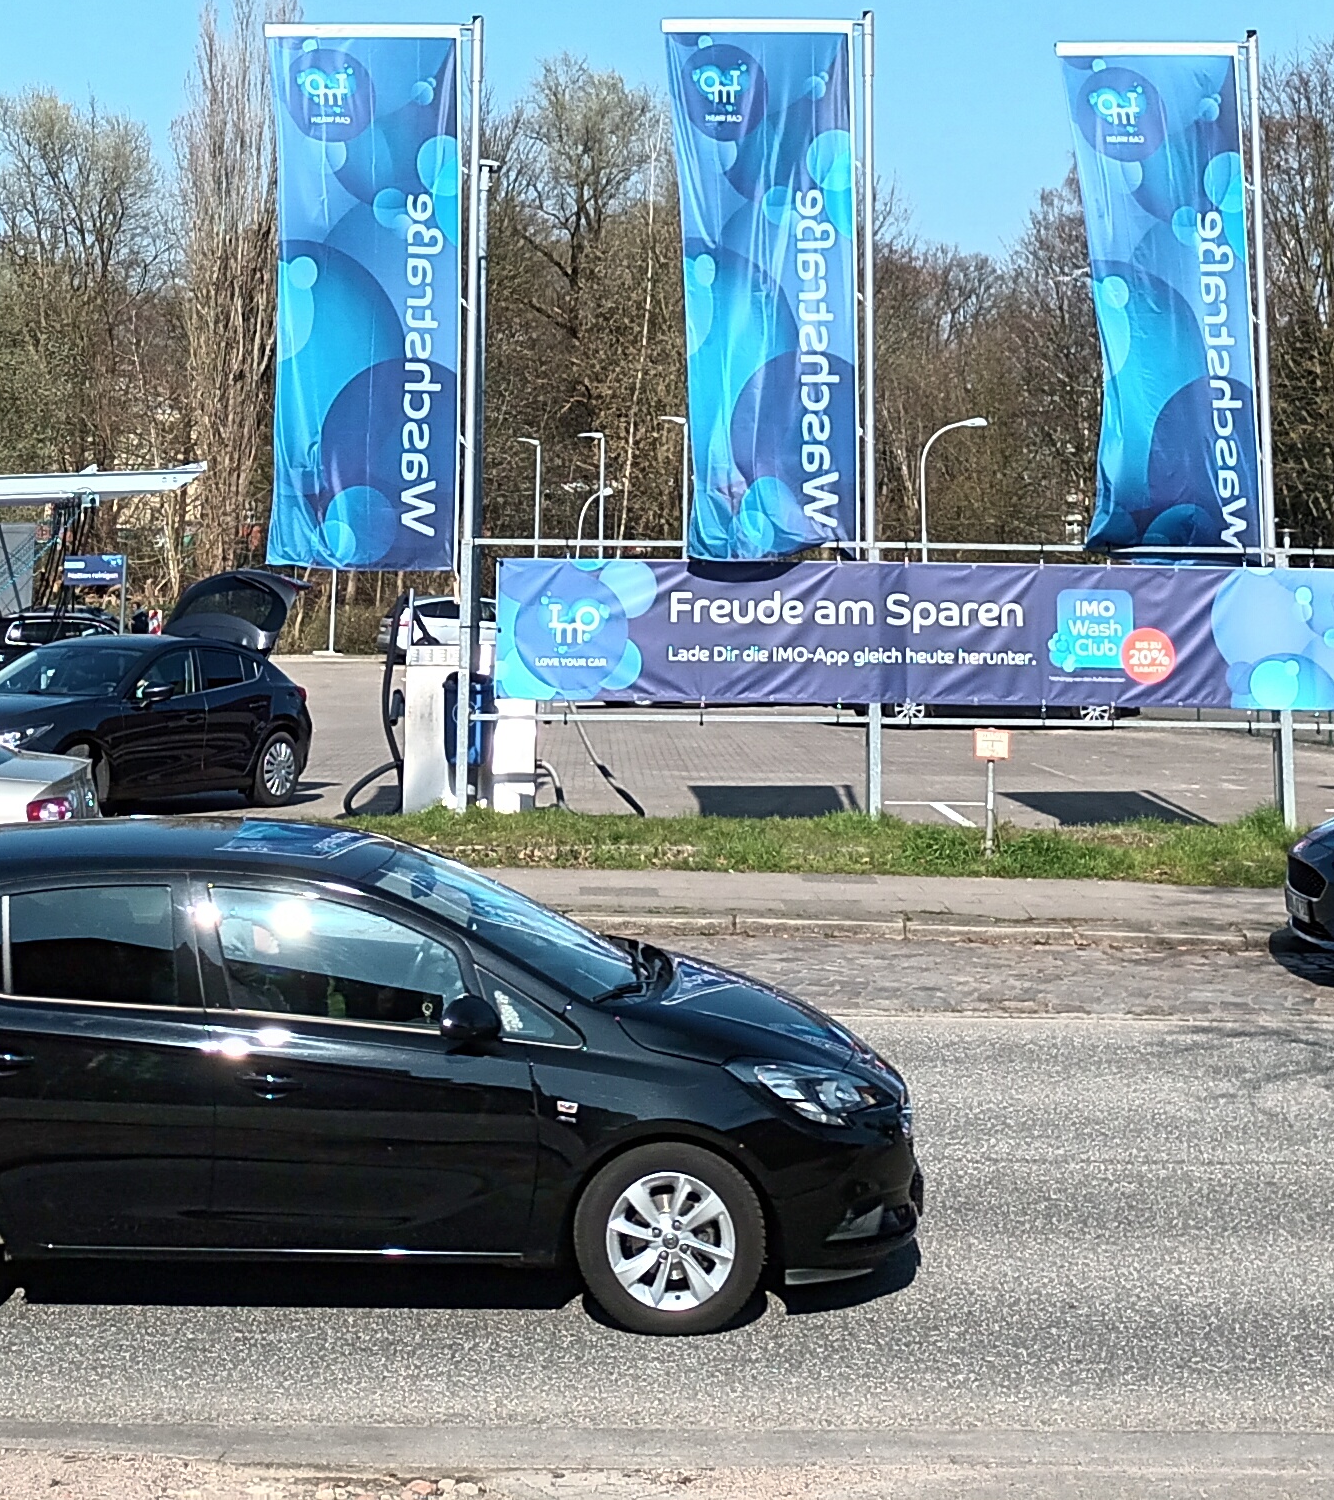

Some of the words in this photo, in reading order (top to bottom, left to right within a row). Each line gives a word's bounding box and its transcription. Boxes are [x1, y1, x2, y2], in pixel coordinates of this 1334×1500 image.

[669, 591, 804, 625] Freude
[814, 604, 874, 625] am
[886, 593, 1024, 633] Sparen
[1075, 600, 1116, 617] IMO
[1067, 619, 1122, 637] Wash
[1074, 638, 1117, 656] Club
[535, 658, 559, 666] LOVE
[560, 658, 586, 666] YOUR
[588, 658, 607, 667] CAR
[668, 646, 710, 662] Lade
[714, 646, 740, 662] Dir
[743, 646, 768, 663] die
[773, 647, 849, 666] IMO-App
[853, 647, 902, 667] gleich
[906, 649, 954, 665] heute
[958, 649, 1037, 666] herunter.
[1129, 649, 1170, 666] 20%
